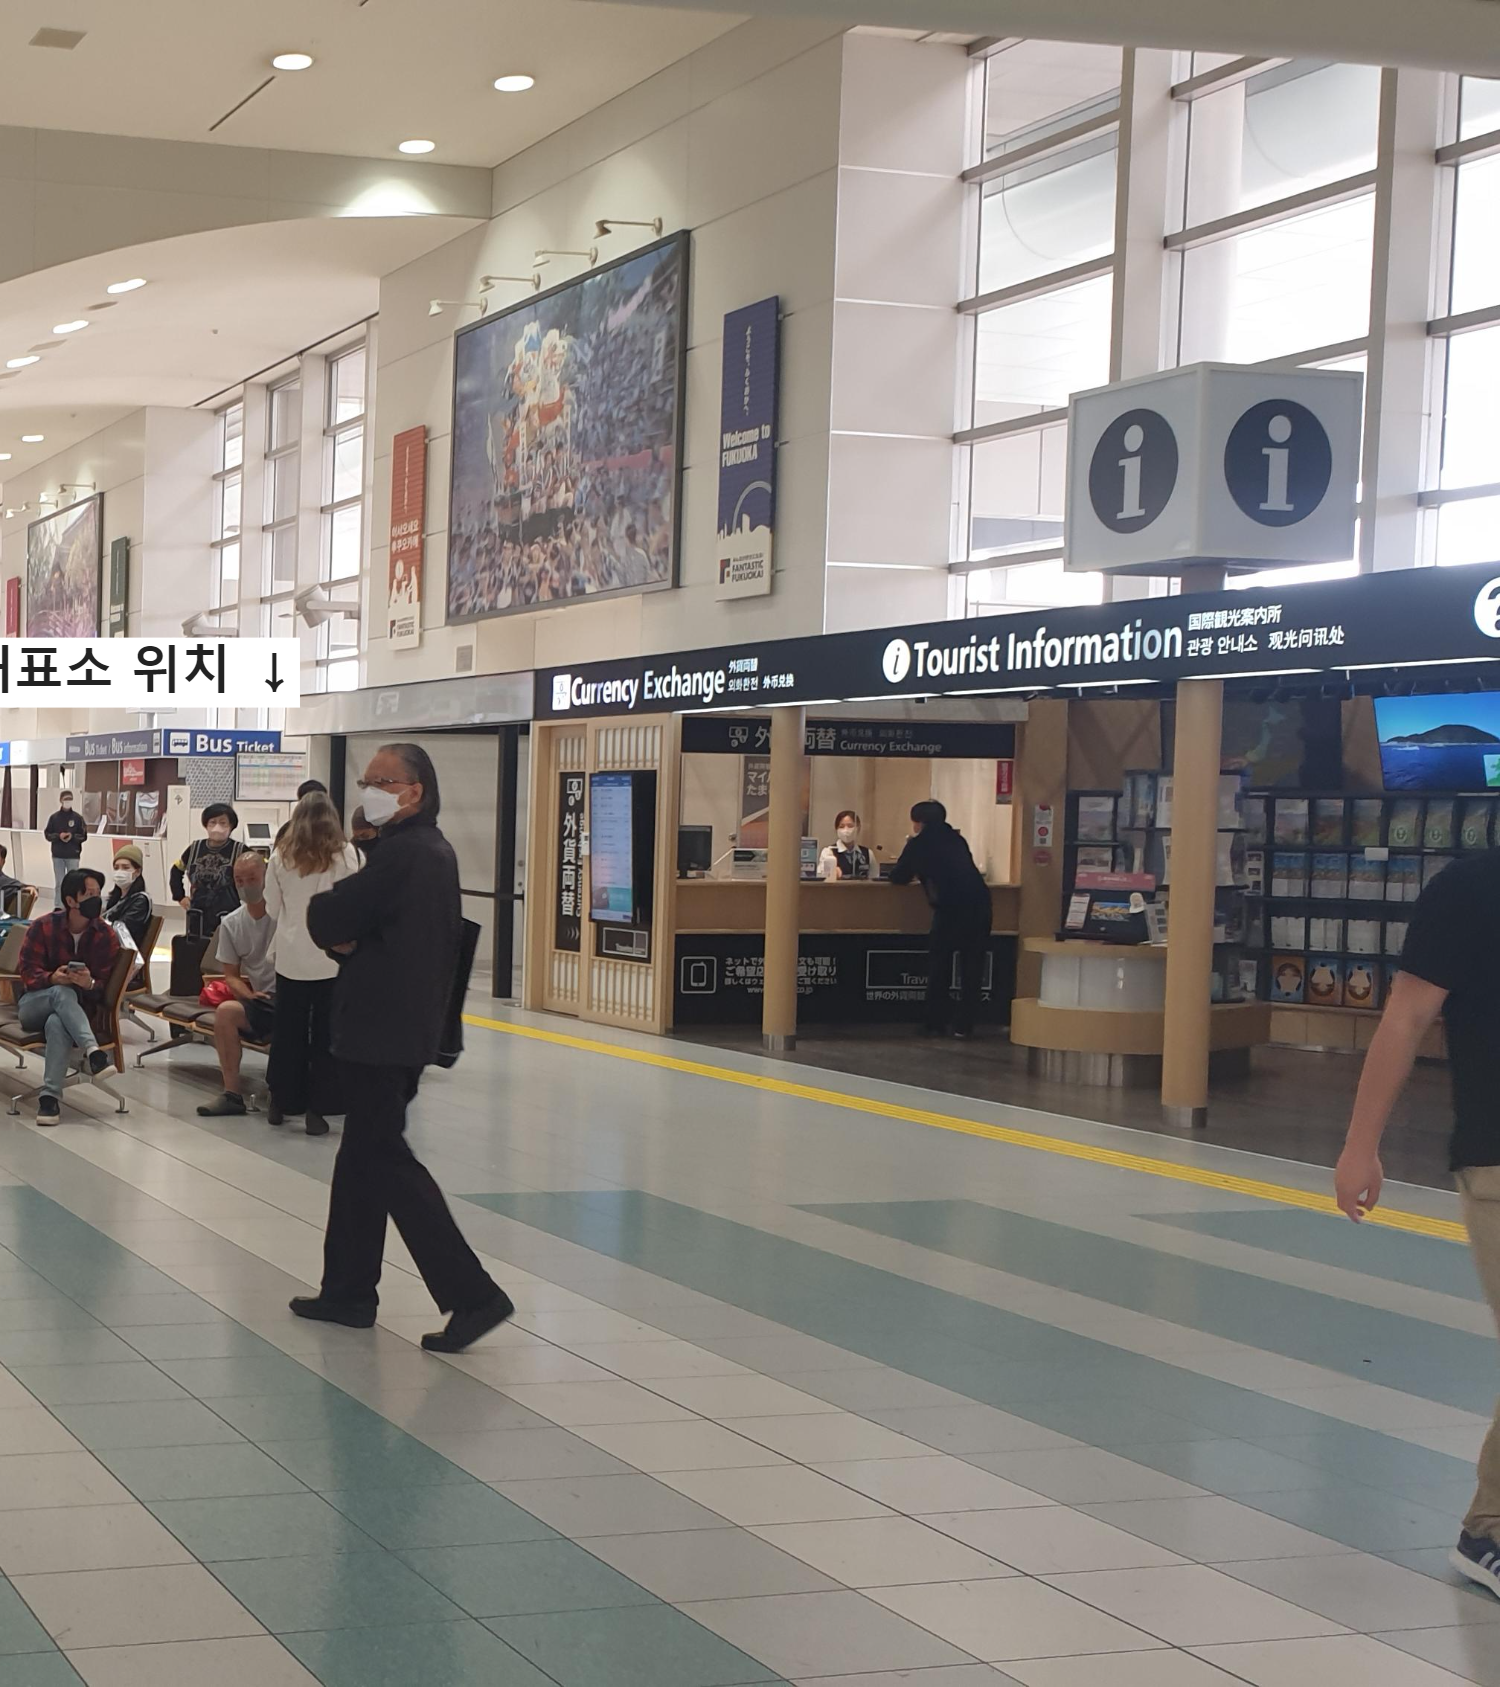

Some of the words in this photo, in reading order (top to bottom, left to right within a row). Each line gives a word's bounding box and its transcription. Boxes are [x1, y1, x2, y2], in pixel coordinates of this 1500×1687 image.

[722, 428, 759, 449] Welcome
[761, 424, 771, 440] to
[722, 443, 758, 467] FUKUOKA
[732, 560, 764, 572] FANTASTIC
[1188, 605, 1282, 631] 国際観光案内所
[914, 634, 999, 678] Tourist
[1007, 619, 1183, 671] Information
[1186, 637, 1212, 657] 관광
[1217, 632, 1258, 655] 안내소
[1268, 624, 1345, 651] 观光问讯处
[728, 658, 759, 674] 外貨両替
[571, 675, 639, 709] Currency
[643, 666, 726, 703] Exchange
[728, 674, 759, 693] 외화환전
[84, 740, 95, 757] Bus
[111, 738, 123, 755] Bus
[195, 734, 232, 753] Bus
[236, 740, 275, 753] Ticket
[839, 740, 886, 753] Currency
[888, 742, 942, 753] Exchange
[561, 811, 577, 918] 外貨両替
